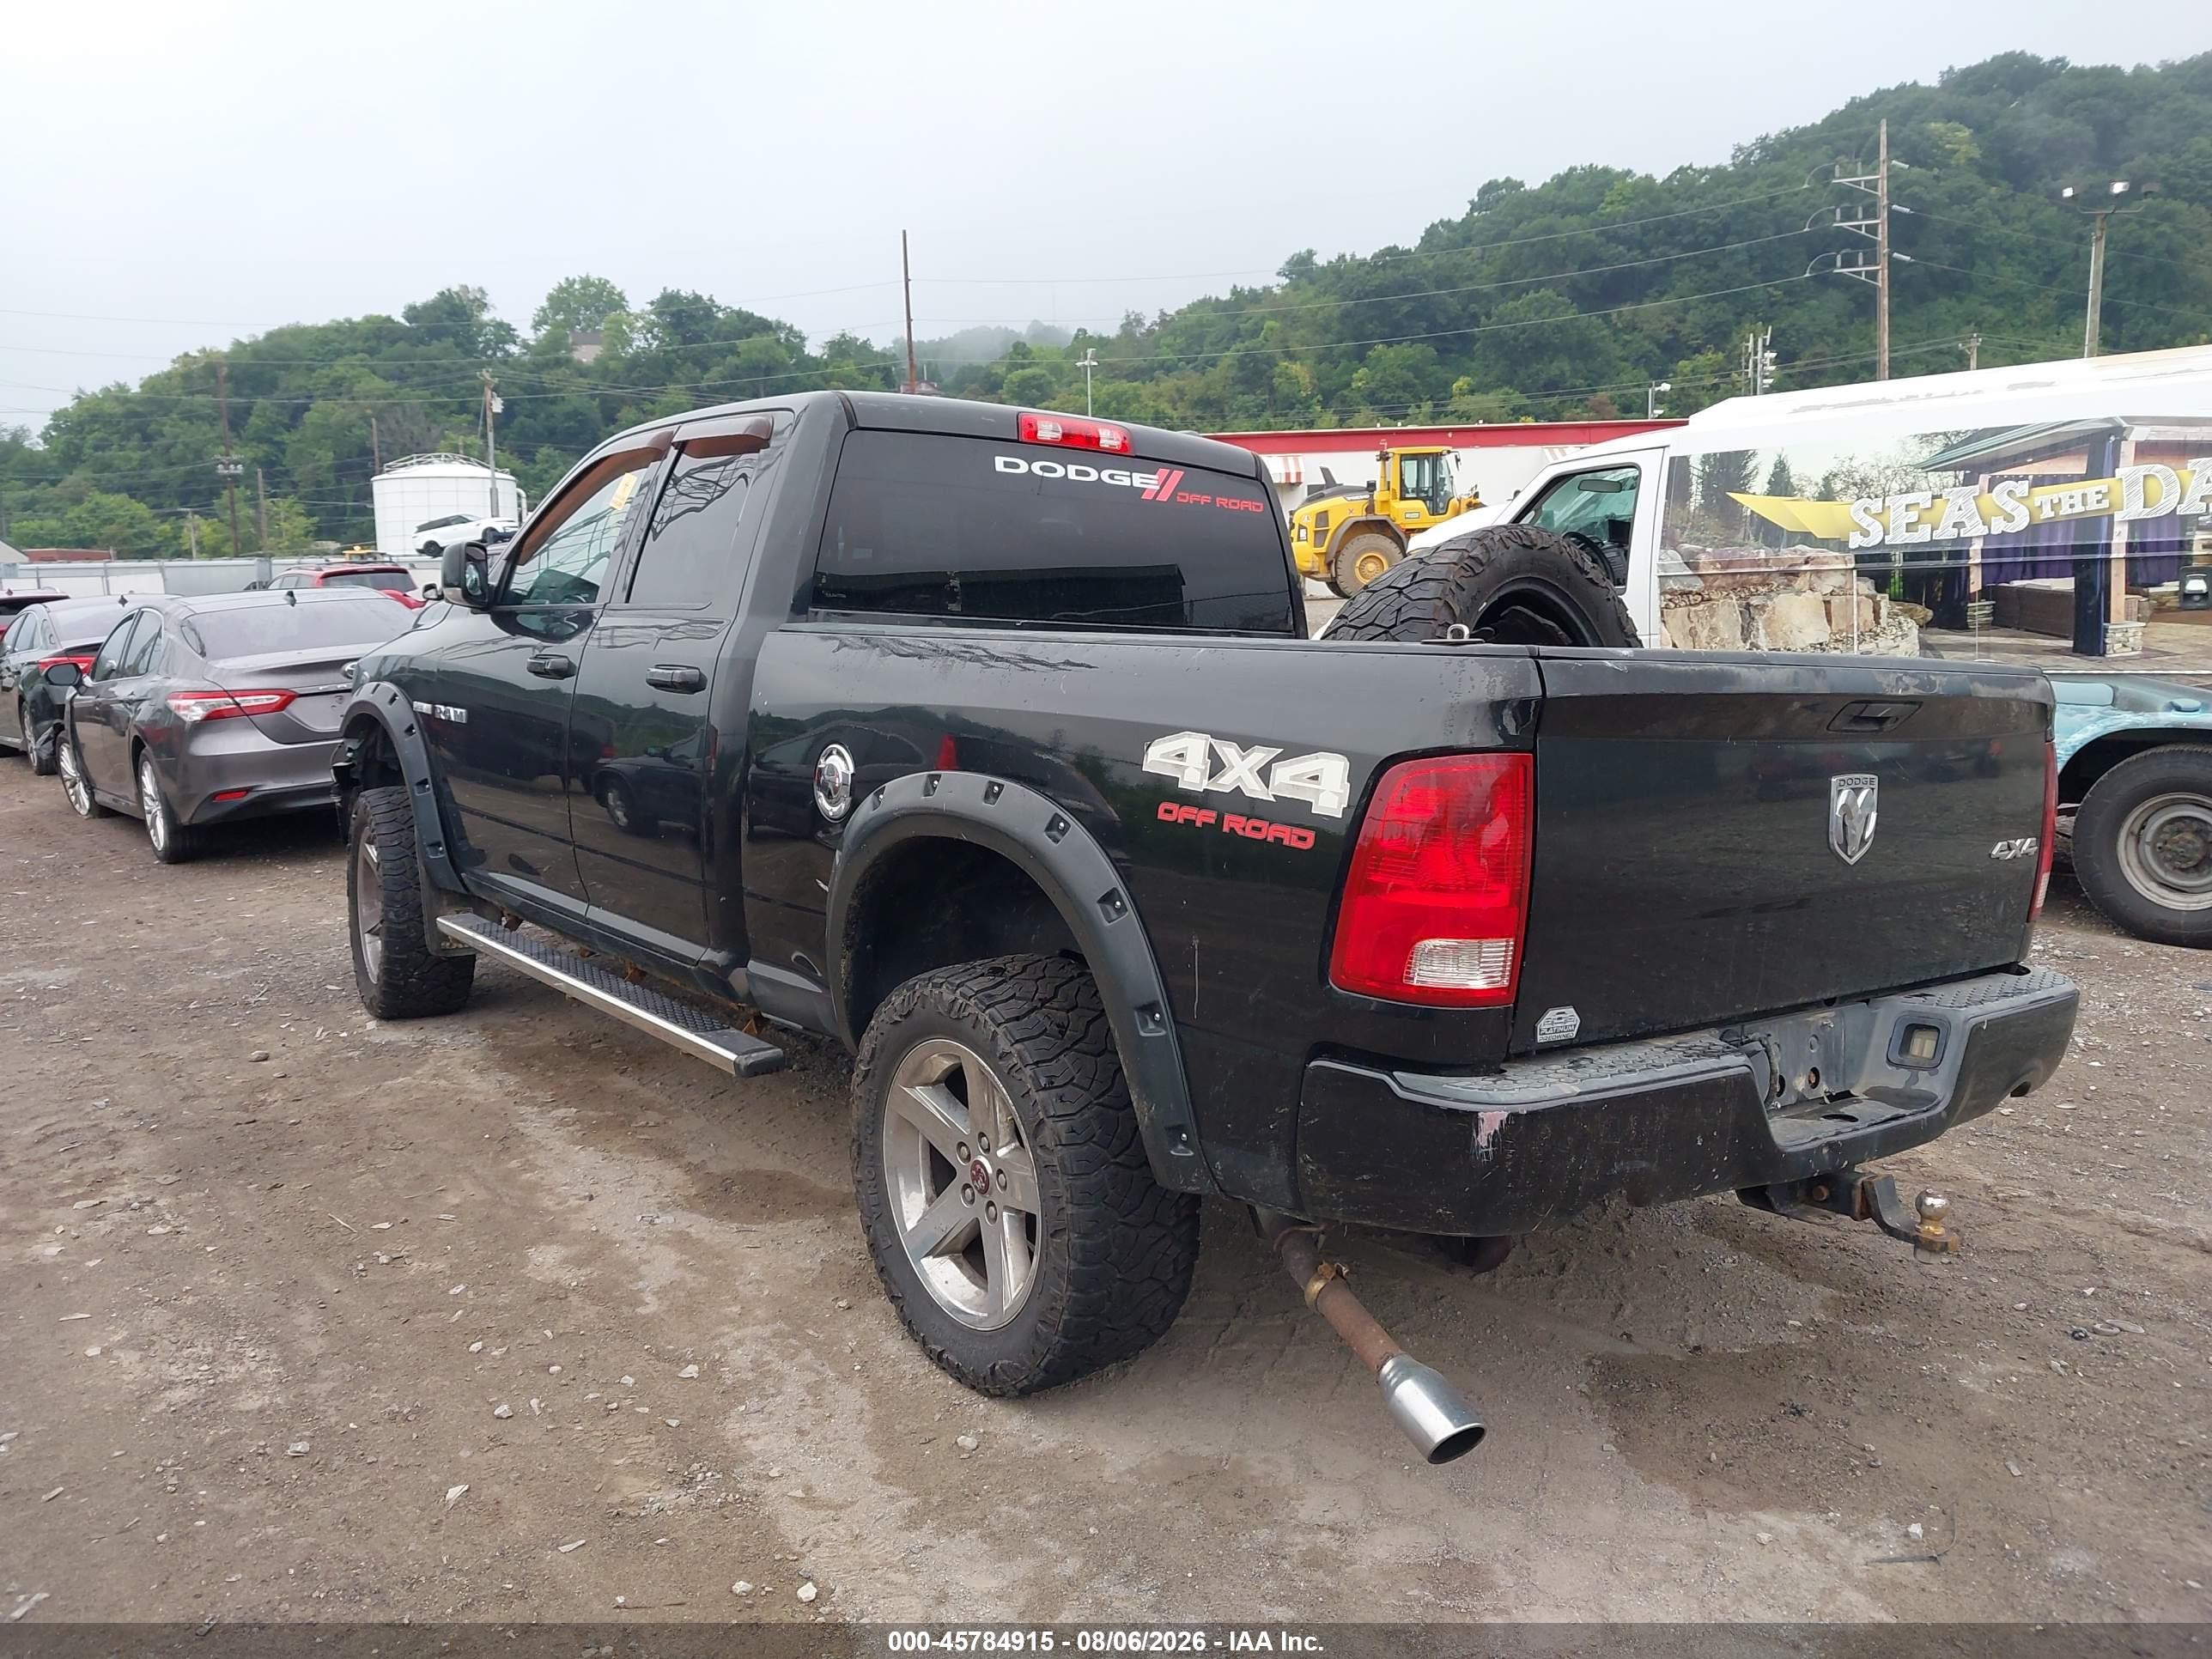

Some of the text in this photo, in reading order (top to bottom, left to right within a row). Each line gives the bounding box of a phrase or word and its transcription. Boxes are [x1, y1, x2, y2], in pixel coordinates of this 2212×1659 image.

[994, 456, 1160, 489] DODGE
[1176, 492, 1264, 513] OFF ROAD
[1849, 479, 2031, 550] SEAS
[2033, 483, 2110, 520] THE
[434, 704, 466, 723] RAM
[1142, 732, 1351, 818] 4X4
[1838, 777, 1876, 787] DODGE
[1158, 801, 1316, 851] OFF ROAD
[1989, 837, 2039, 860] 4X4
[1540, 1024, 1576, 1036] PLATINUM
